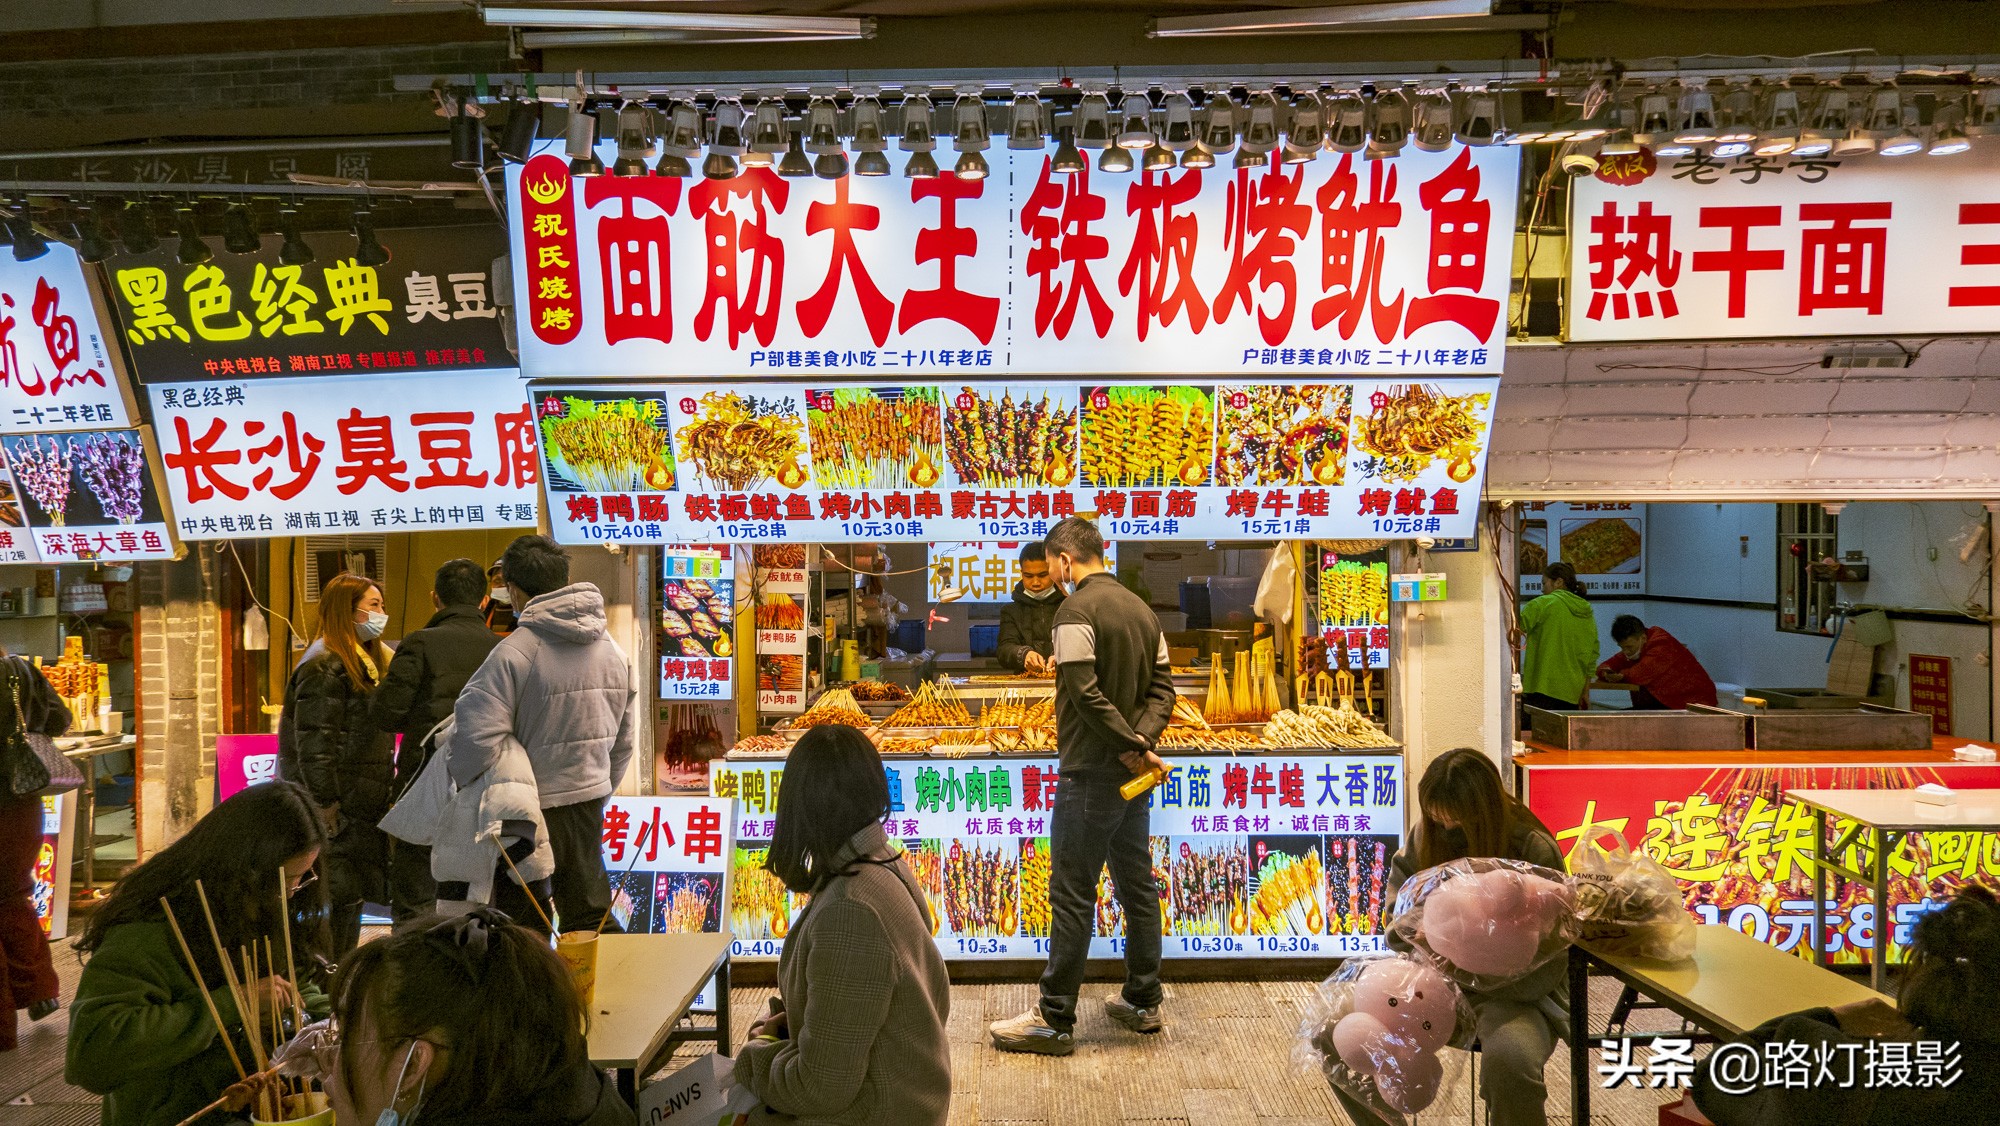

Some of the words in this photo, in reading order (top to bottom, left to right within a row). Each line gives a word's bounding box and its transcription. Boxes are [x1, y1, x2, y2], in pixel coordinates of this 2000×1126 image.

[1600, 155, 1649, 179] 武汉
[1671, 148, 1841, 184] 老字号
[584, 150, 1000, 350] 面筋大王
[1020, 146, 1500, 346] 铁板烤鱿鱼
[531, 212, 575, 331] 祝氏烧烤
[1585, 201, 1892, 321] 热干面
[116, 257, 393, 346] 黑色经典
[405, 271, 497, 322] 臭豆
[204, 356, 282, 377] 中央电视台
[289, 353, 352, 373] 湖南卫视
[356, 350, 418, 369] 专题报道
[425, 347, 487, 366] 推荐美食
[749, 350, 877, 368] 户部巷美食小吃
[883, 350, 993, 368] 二十八年老店
[1242, 348, 1370, 366] 户部巷美食小吃
[1377, 348, 1487, 366] 二十八年老店
[162, 385, 245, 410] 黑色经典
[13, 403, 114, 426] 二十二年老店
[566, 494, 670, 524] 烤鸭肠
[684, 493, 815, 522] 铁板鱿鱼
[820, 491, 943, 521] 烤小肉串
[950, 490, 1076, 519] 蒙古大肉串
[1094, 489, 1198, 518] 烤面筋
[1226, 488, 1330, 518] 烤牛蛙
[1358, 487, 1460, 516] 烤鱿鱼
[180, 513, 274, 535] 中央电视台
[284, 509, 360, 530] 湖南卫视
[370, 505, 485, 526] 舌尖上的中国
[495, 502, 538, 522] 专题
[717, 522, 787, 539] 10元8串
[841, 520, 923, 538] 10元30串
[978, 519, 1049, 537] 10元3串
[1109, 518, 1180, 536] 10元4串
[1241, 518, 1311, 535] 15元1串
[1373, 517, 1441, 534] 10元8串
[42, 530, 166, 556] 深海大章鱼
[580, 522, 662, 540] 10元40串
[929, 554, 1022, 600] 祝氏串
[760, 632, 797, 644] 烤鸭肠
[1324, 627, 1388, 650] 烤面筋
[663, 658, 730, 682] 烤鸡翅
[672, 682, 720, 696] 15元2串
[761, 693, 797, 706] 小肉串
[915, 765, 1012, 813] 烤小肉串
[1149, 764, 1210, 810] 面筋
[1222, 762, 1305, 810] 烤牛蛙
[1316, 762, 1397, 808] 大香肠
[884, 819, 920, 837] 商家
[966, 817, 1045, 836] 优质食材
[1191, 814, 1371, 832] 优质食材·诚信商家
[1330, 912, 1371, 934] 大香肠
[957, 938, 1008, 954] 10元3串
[1180, 937, 1243, 953] 10元30串
[1257, 936, 1320, 952] 10元30串
[1339, 936, 1390, 952] 13元1串
